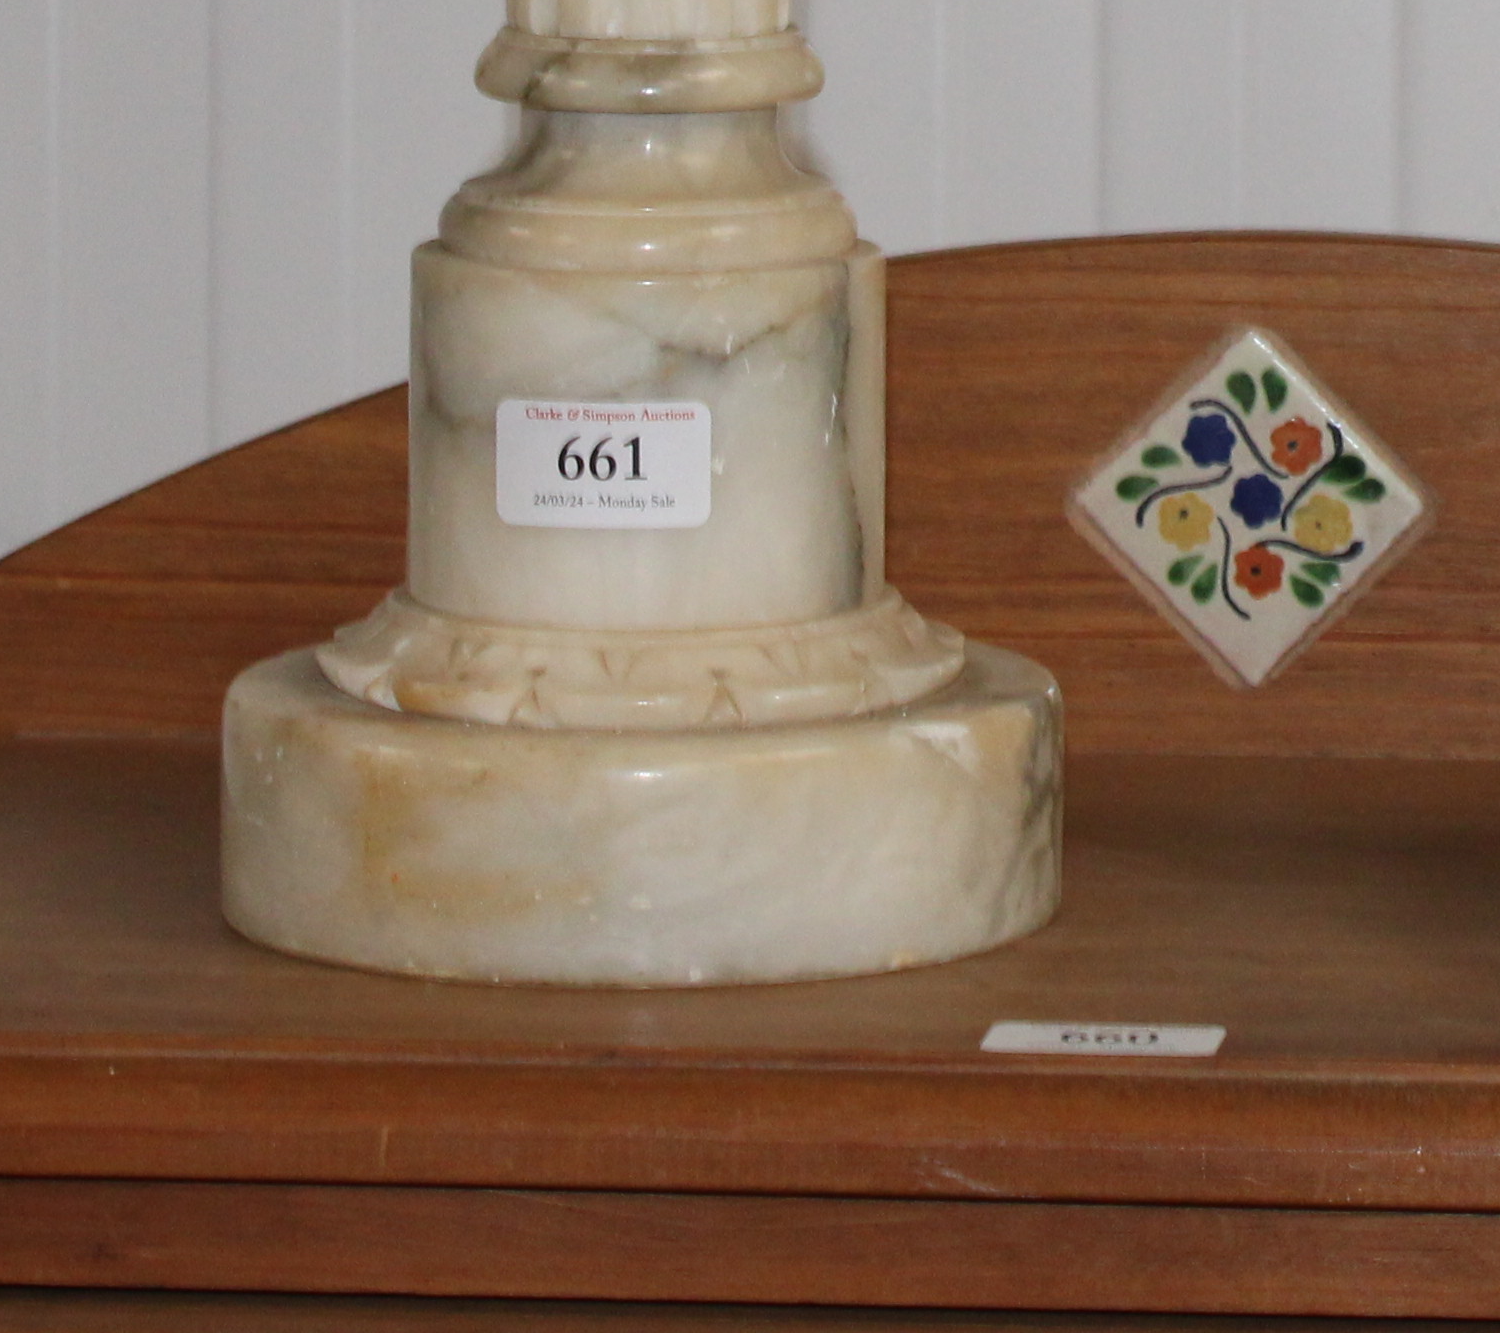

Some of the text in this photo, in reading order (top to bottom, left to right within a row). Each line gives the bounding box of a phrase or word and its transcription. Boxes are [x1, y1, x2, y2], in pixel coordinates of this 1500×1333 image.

[525, 407, 696, 425] Clarke & Simpson Auctions
[557, 434, 649, 482] 661
[598, 495, 647, 511] Monday
[651, 493, 676, 508] Sale
